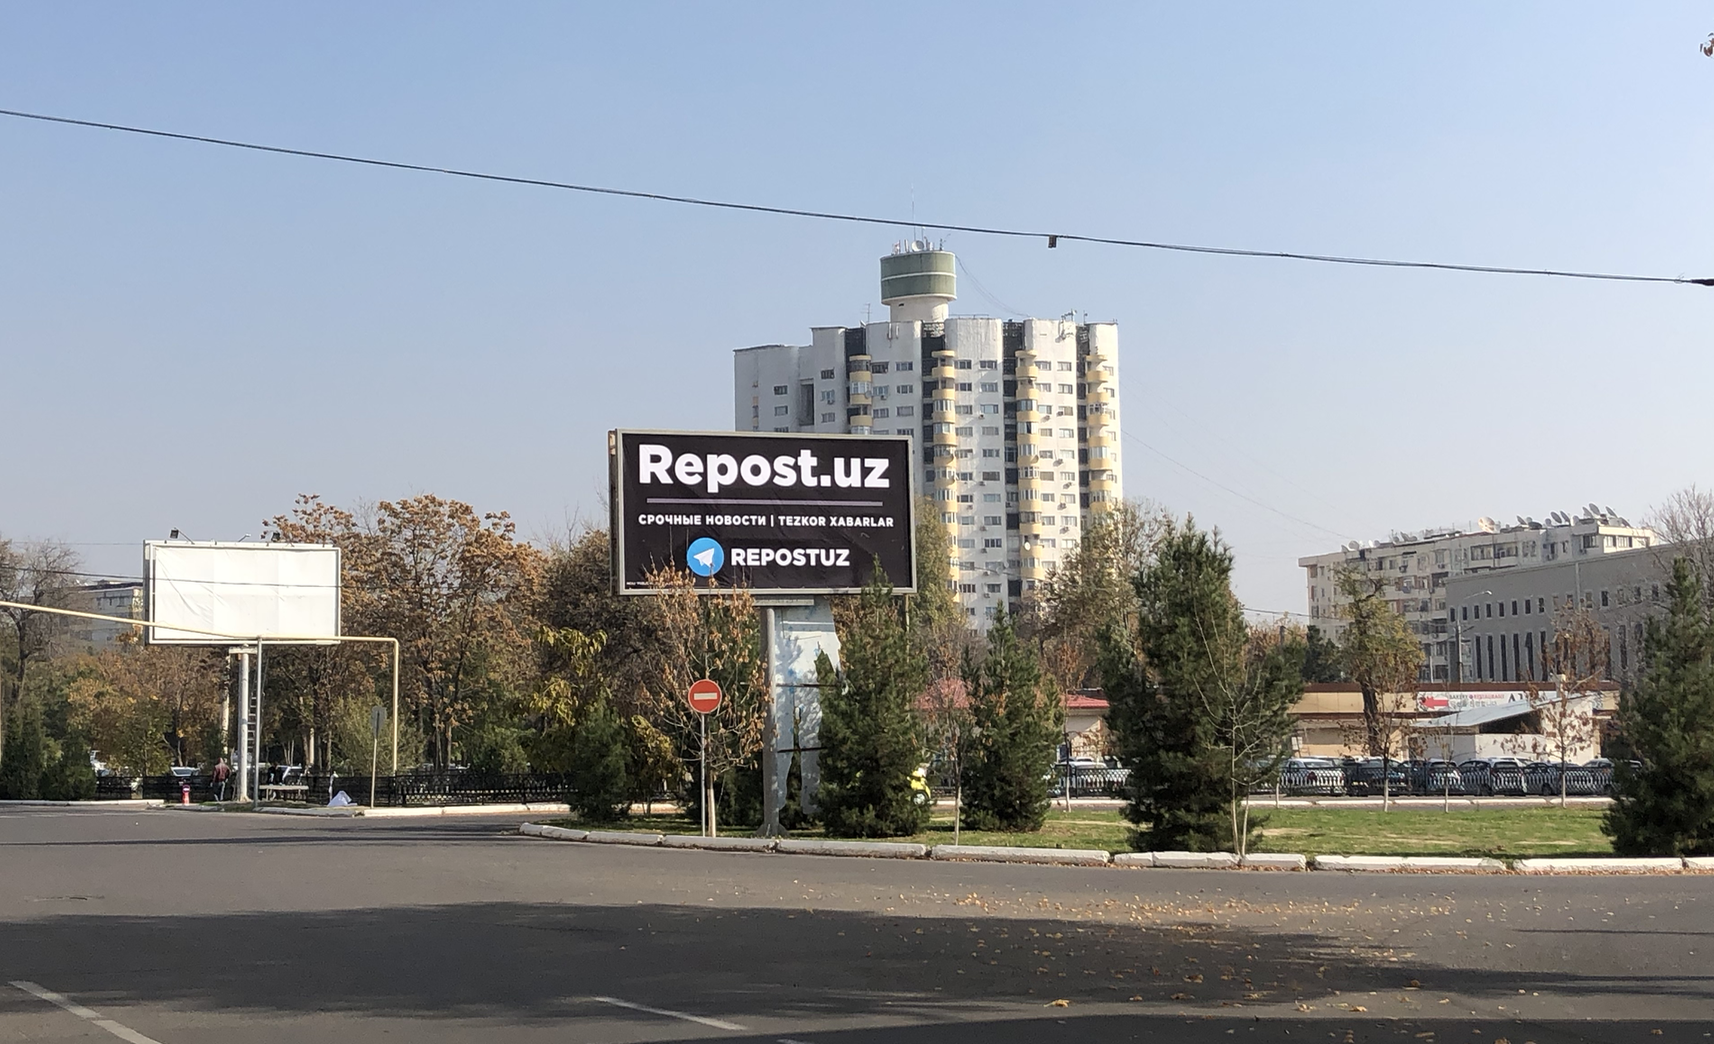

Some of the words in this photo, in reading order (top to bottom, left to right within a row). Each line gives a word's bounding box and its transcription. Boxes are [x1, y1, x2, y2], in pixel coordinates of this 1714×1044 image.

[638, 443, 890, 493] Repost.uz
[638, 514, 702, 526] СРОЧНЫЕ
[705, 515, 767, 526] НОВОСТИ
[778, 515, 826, 527] TEZKOR
[829, 516, 894, 528] XABARLAR
[731, 548, 850, 567] REPOSTUZ
